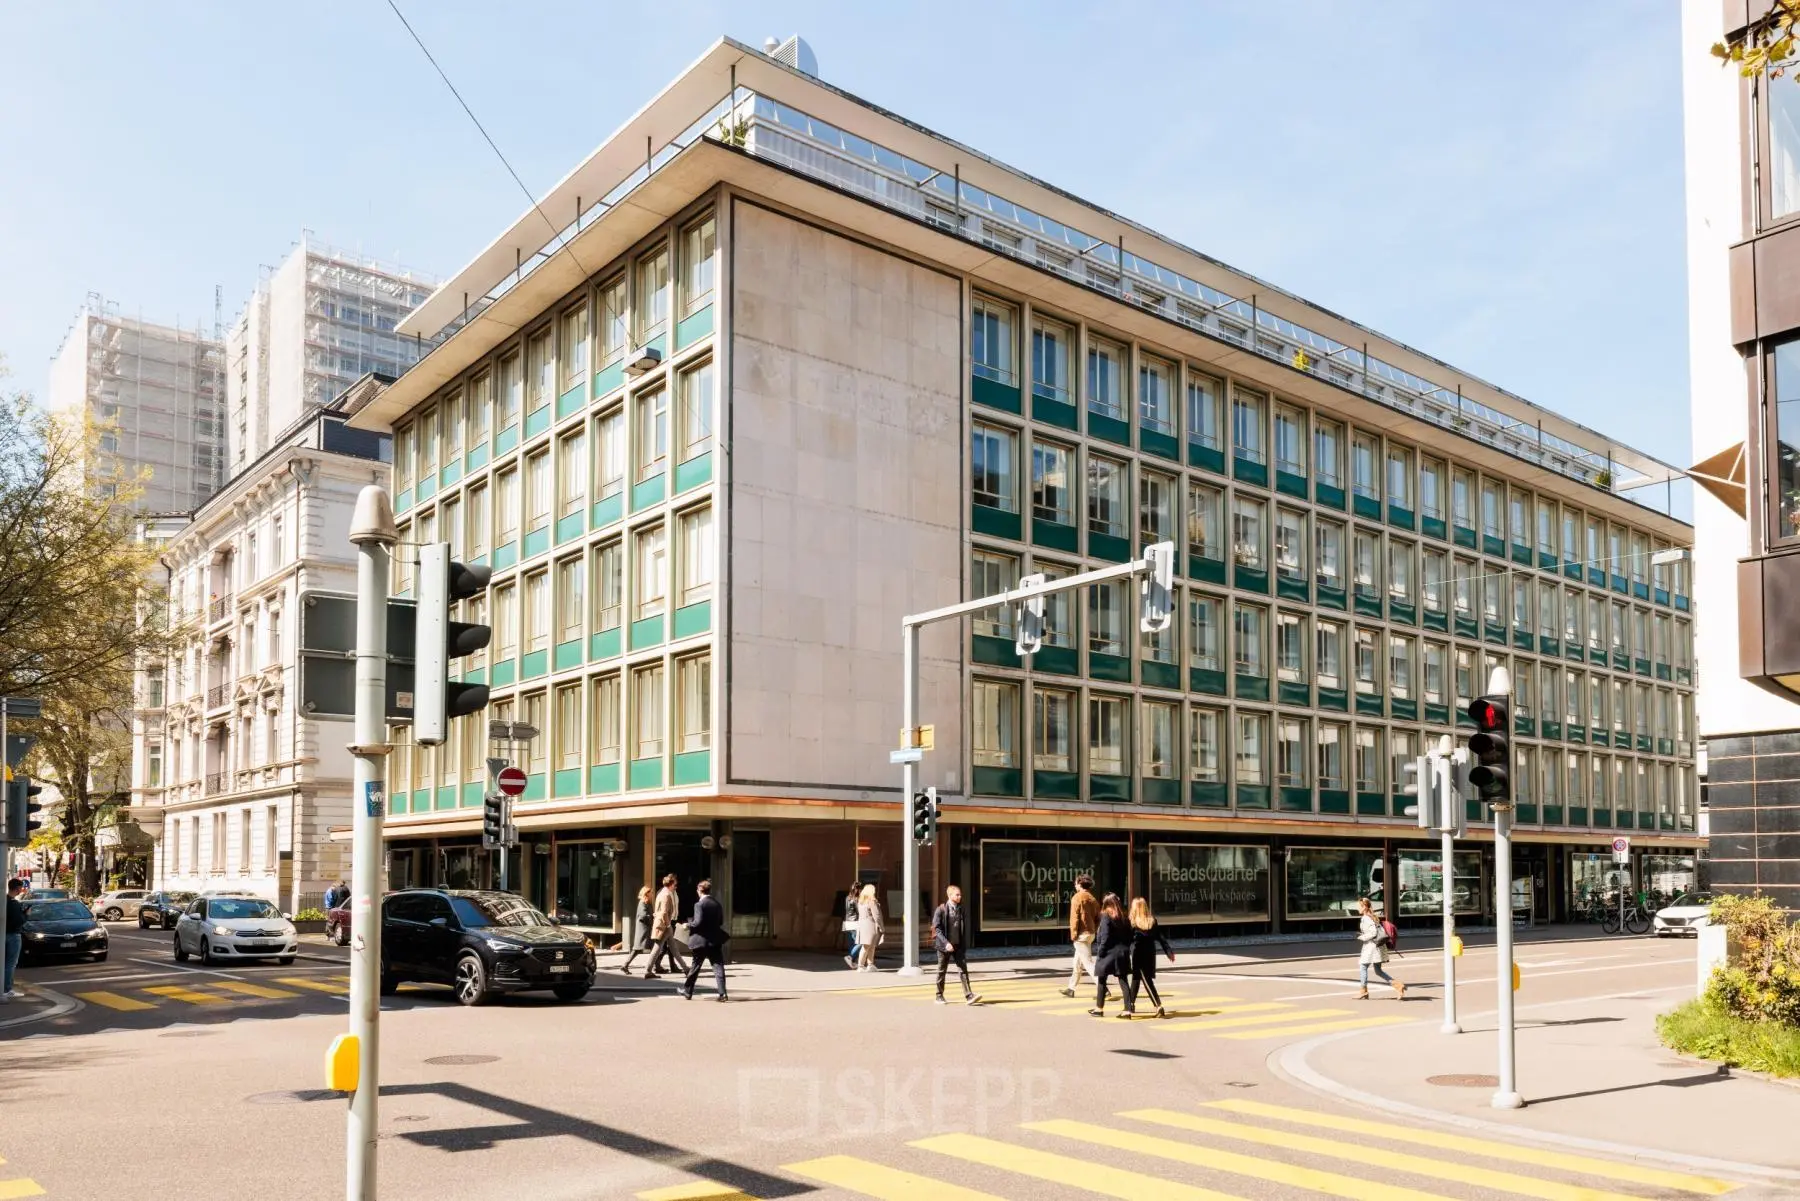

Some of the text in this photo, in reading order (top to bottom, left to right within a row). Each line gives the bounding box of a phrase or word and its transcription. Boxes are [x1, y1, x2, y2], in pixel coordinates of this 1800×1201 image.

[1020, 860, 1096, 889] Opening
[1159, 863, 1260, 883] HeadsQuarter
[1027, 890, 1061, 904] March
[1164, 887, 1256, 905] Living Workspaces
